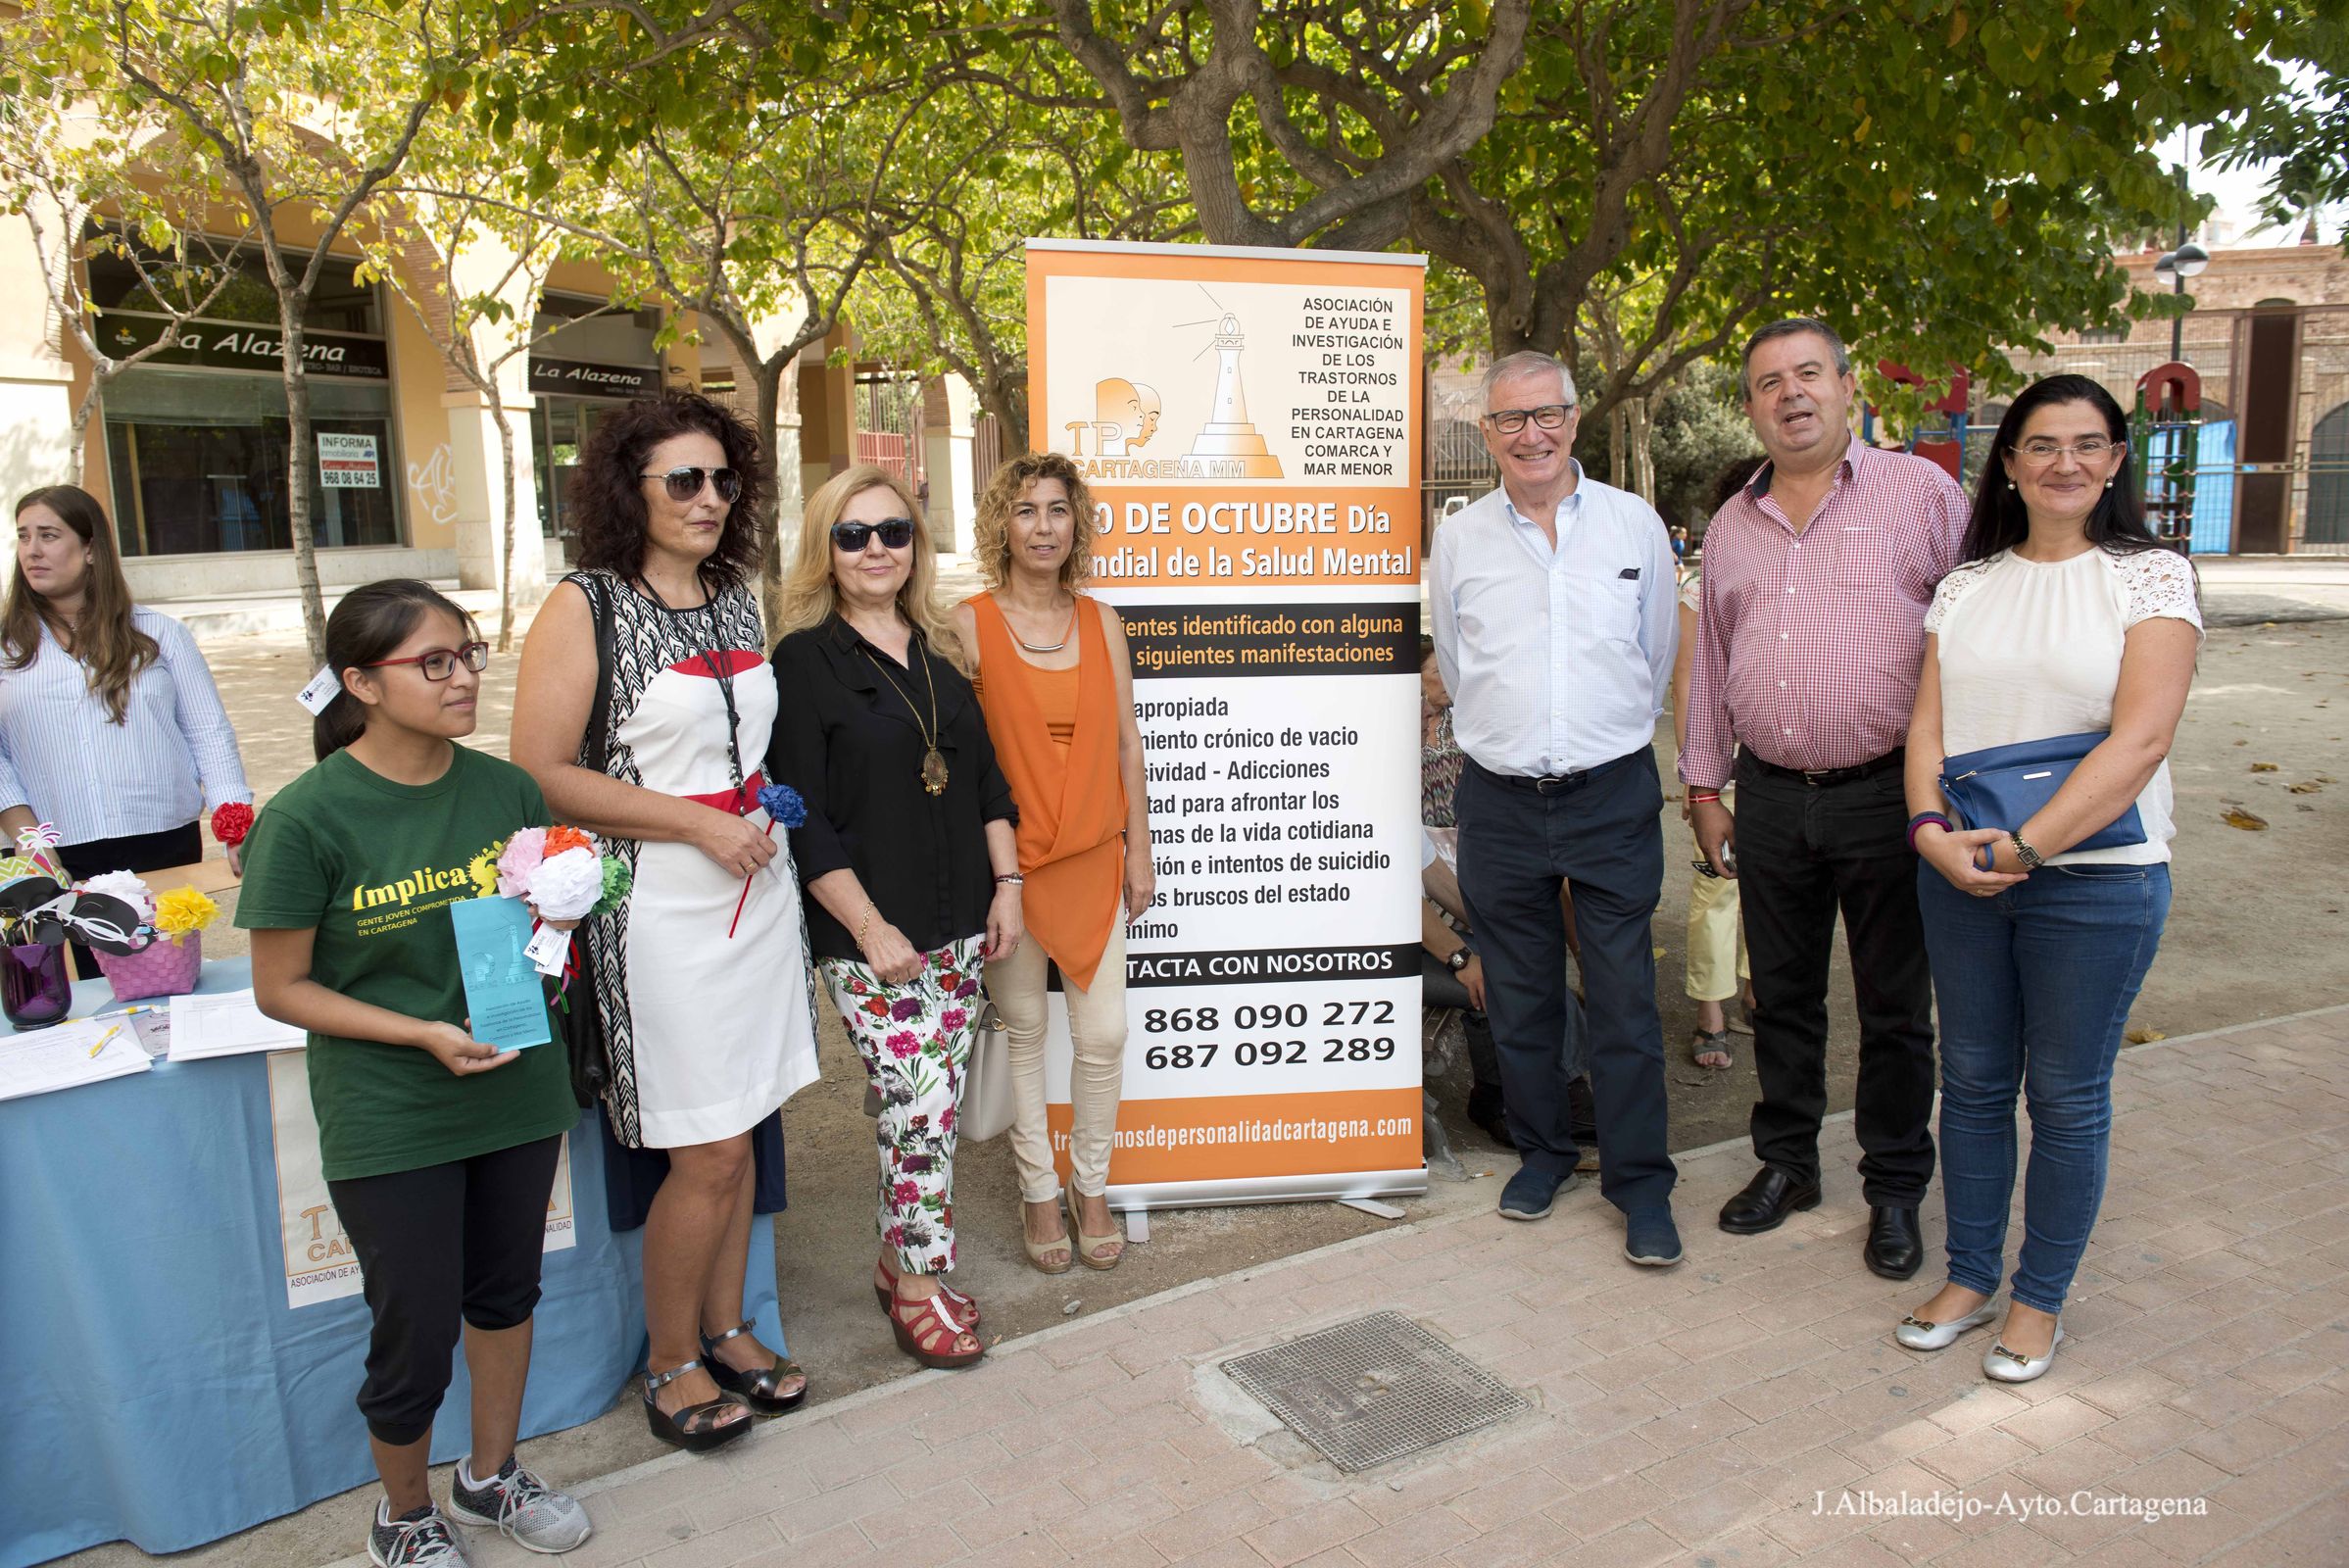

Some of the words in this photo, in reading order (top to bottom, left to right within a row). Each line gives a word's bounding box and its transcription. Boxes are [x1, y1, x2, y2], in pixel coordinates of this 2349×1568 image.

[1303, 298, 1393, 313] ASOCIACIÓN
[1305, 317, 1324, 328] DE
[1329, 318, 1379, 330] AYUDA
[1384, 319, 1391, 330] E
[1293, 334, 1403, 349] INVESTIGACIÓN
[1323, 354, 1342, 366] DE
[1346, 355, 1375, 366] LOS
[534, 364, 560, 378] La
[565, 368, 642, 385] Alazena
[1298, 371, 1396, 385] TRASTORNOS
[1328, 391, 1346, 402] DE
[1351, 391, 1370, 403] LA
[1292, 409, 1403, 421] PERSONALIDAD
[322, 437, 372, 448] INFORMA
[1292, 427, 1310, 438] EN
[1315, 427, 1403, 439] CARTAGENA
[1305, 445, 1379, 458] COMARCA
[1384, 446, 1392, 457] Y
[323, 472, 339, 484] 968
[342, 472, 352, 484] 08
[354, 472, 364, 484] 64
[367, 473, 376, 484] 25
[1072, 460, 1203, 478] CARTAGENA
[1210, 461, 1246, 478] MM
[1304, 464, 1336, 475] MAR
[1342, 464, 1393, 475] MENOR
[1097, 503, 1114, 534] 0
[1126, 503, 1170, 533] DE
[1182, 503, 1337, 534] OCTUBRE
[1348, 505, 1391, 533] Día
[1094, 547, 1158, 577] ndial
[1167, 547, 1200, 577] de
[1209, 547, 1233, 576] la
[1242, 546, 1314, 576] Salud
[1323, 546, 1412, 575] Mental
[1121, 616, 1177, 636] ientes
[1183, 614, 1297, 635] identificado
[1301, 619, 1335, 633] con
[1341, 613, 1402, 638] alguna
[1137, 645, 1235, 670] siguientes
[1241, 643, 1394, 663] manifestaciones
[1135, 697, 1229, 721] apropiada
[1204, 728, 1274, 749] crónico
[1280, 727, 1301, 746] de
[1309, 726, 1358, 746] vacio
[1227, 760, 1330, 780] Adicciones
[1148, 795, 1175, 813] tad
[1183, 797, 1225, 817] para
[1231, 792, 1306, 811] afrontar
[1312, 791, 1339, 809] los
[1150, 829, 1185, 844] mas
[1192, 824, 1213, 843] de
[1221, 824, 1236, 842] la
[1243, 822, 1281, 841] vida
[1288, 820, 1373, 840] cotidiana
[1192, 859, 1201, 874] e
[1209, 855, 1284, 874] intentos
[1291, 853, 1312, 871] de
[1318, 851, 1390, 870] suicidio
[1174, 888, 1248, 906] bruscos
[1255, 885, 1281, 904] del
[1289, 883, 1349, 903] estado
[357, 916, 383, 927] GENTE
[385, 909, 411, 923] JOVEN
[412, 896, 465, 914] COMPROMETIDA
[371, 918, 417, 934] CARTAGENA
[1126, 958, 1201, 978] TACTA
[1209, 956, 1258, 975] CON
[1267, 952, 1393, 973] NOSOTROS
[1145, 1007, 1219, 1033] 868
[1234, 1004, 1307, 1029] 090
[1323, 1001, 1395, 1026] 272
[1146, 1045, 1218, 1070] 687
[1235, 1041, 1307, 1066] 092
[1323, 1037, 1395, 1062] 289
[291, 1271, 337, 1289] ASOCIACIÓN
[339, 1268, 349, 1278] DE
